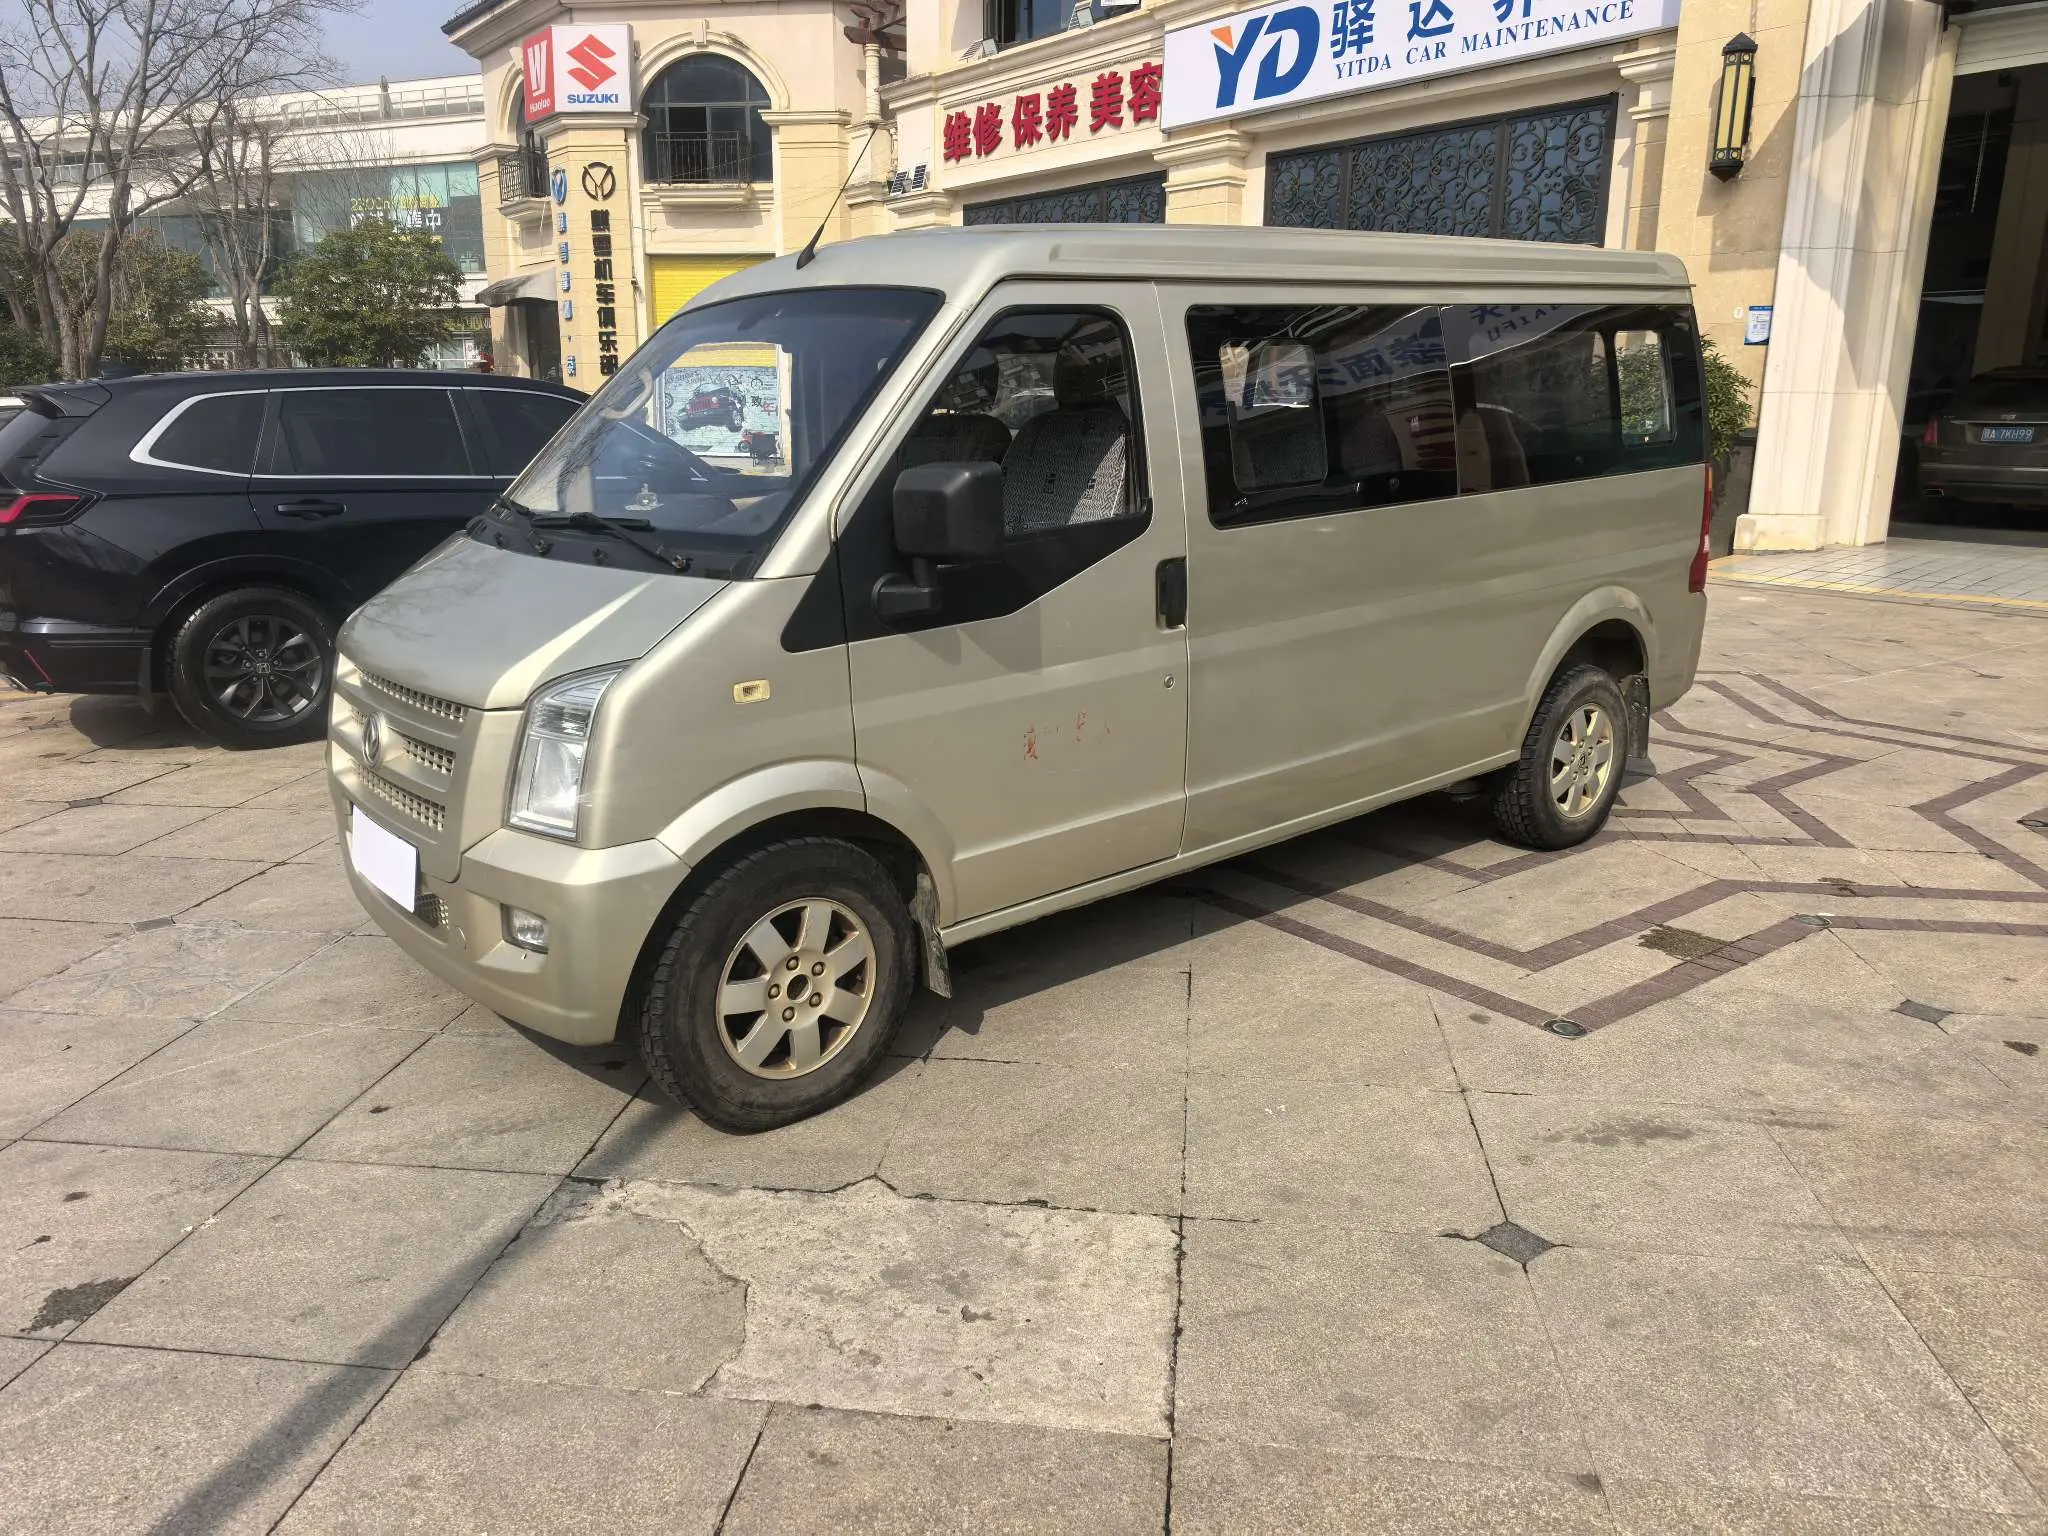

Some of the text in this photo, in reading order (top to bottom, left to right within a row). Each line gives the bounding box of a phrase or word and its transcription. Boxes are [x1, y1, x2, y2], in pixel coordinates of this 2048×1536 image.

[1335, 0, 1634, 80] YITDA CAR MAINTENANCE
[567, 93, 619, 105] SUZUKI
